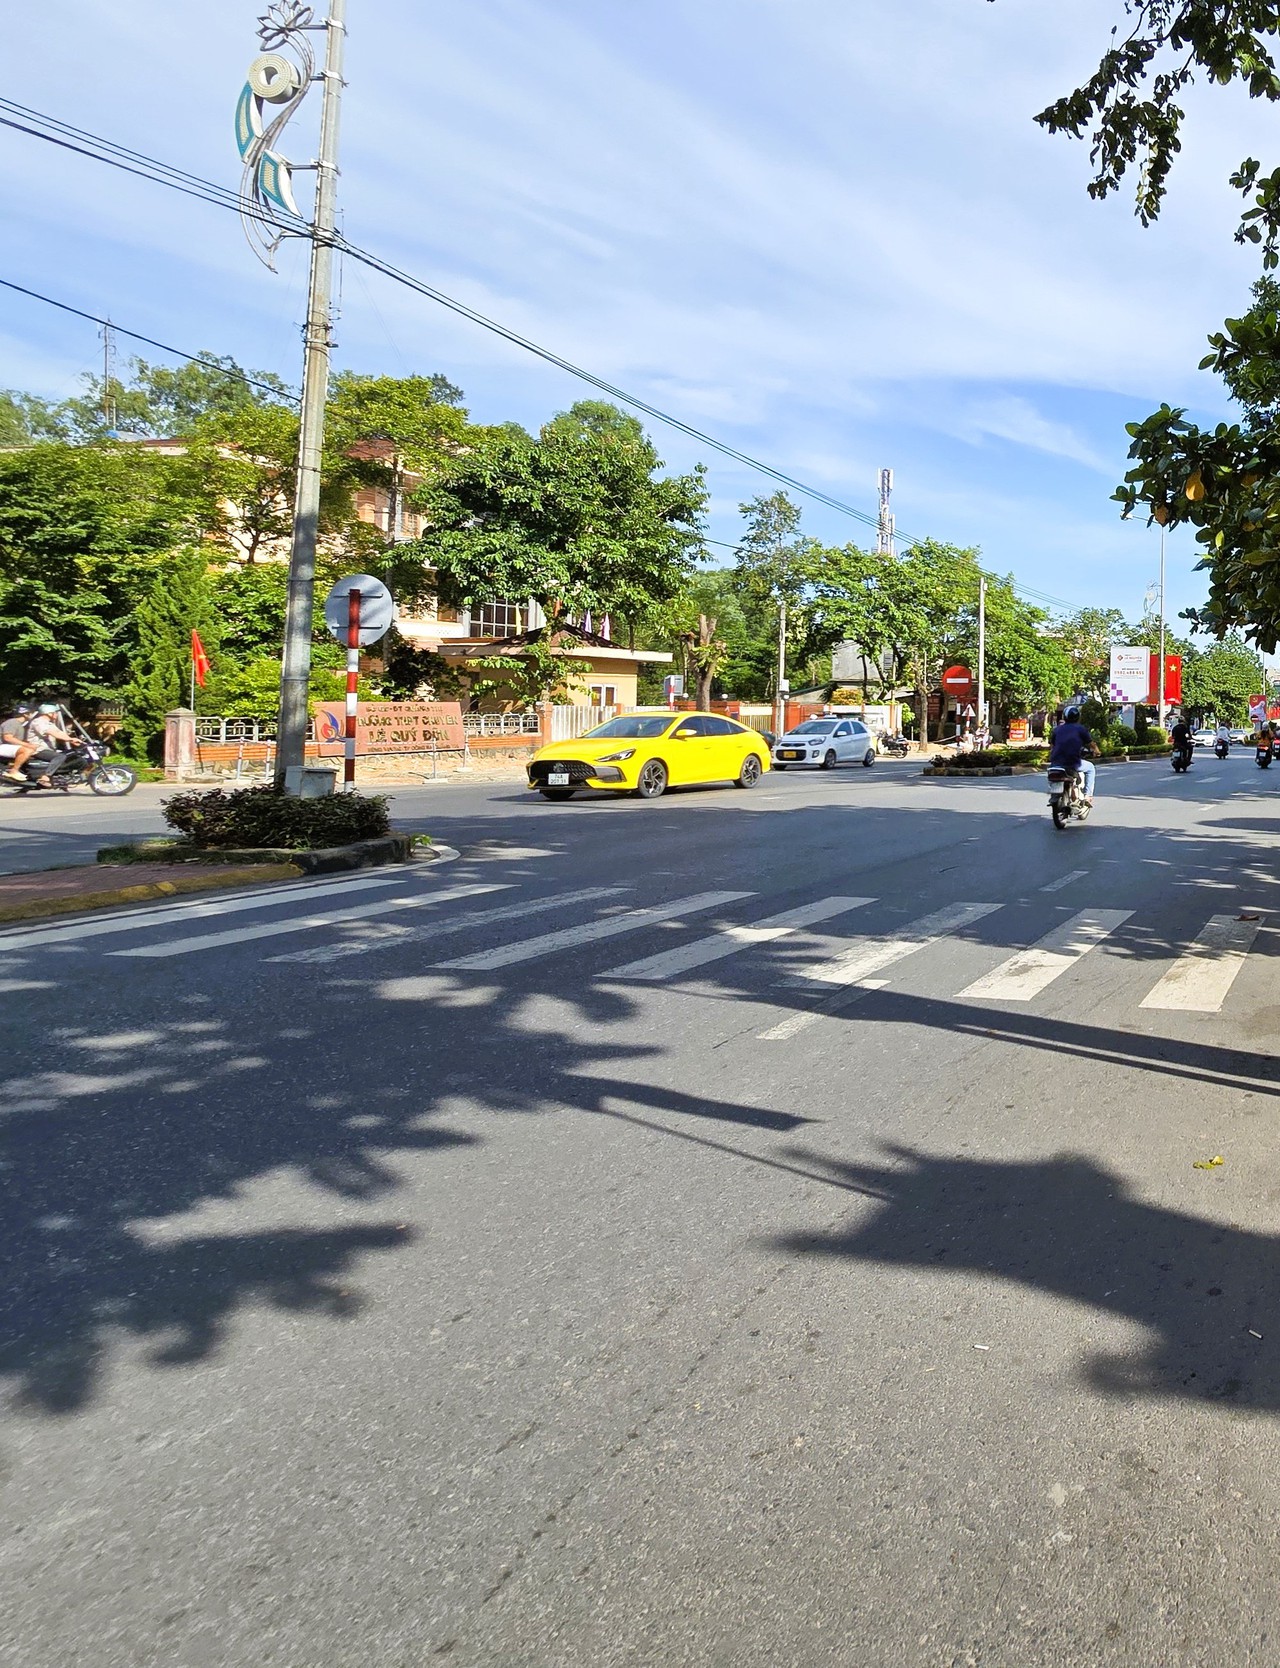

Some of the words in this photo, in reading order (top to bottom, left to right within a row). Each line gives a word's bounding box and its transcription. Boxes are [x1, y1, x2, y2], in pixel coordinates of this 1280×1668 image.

[394, 716, 419, 726] THPT
[422, 715, 459, 726] CHUYÊN
[368, 728, 387, 743] LÊ
[390, 727, 418, 742] QUÝ
[422, 727, 450, 742] ĐÔN
